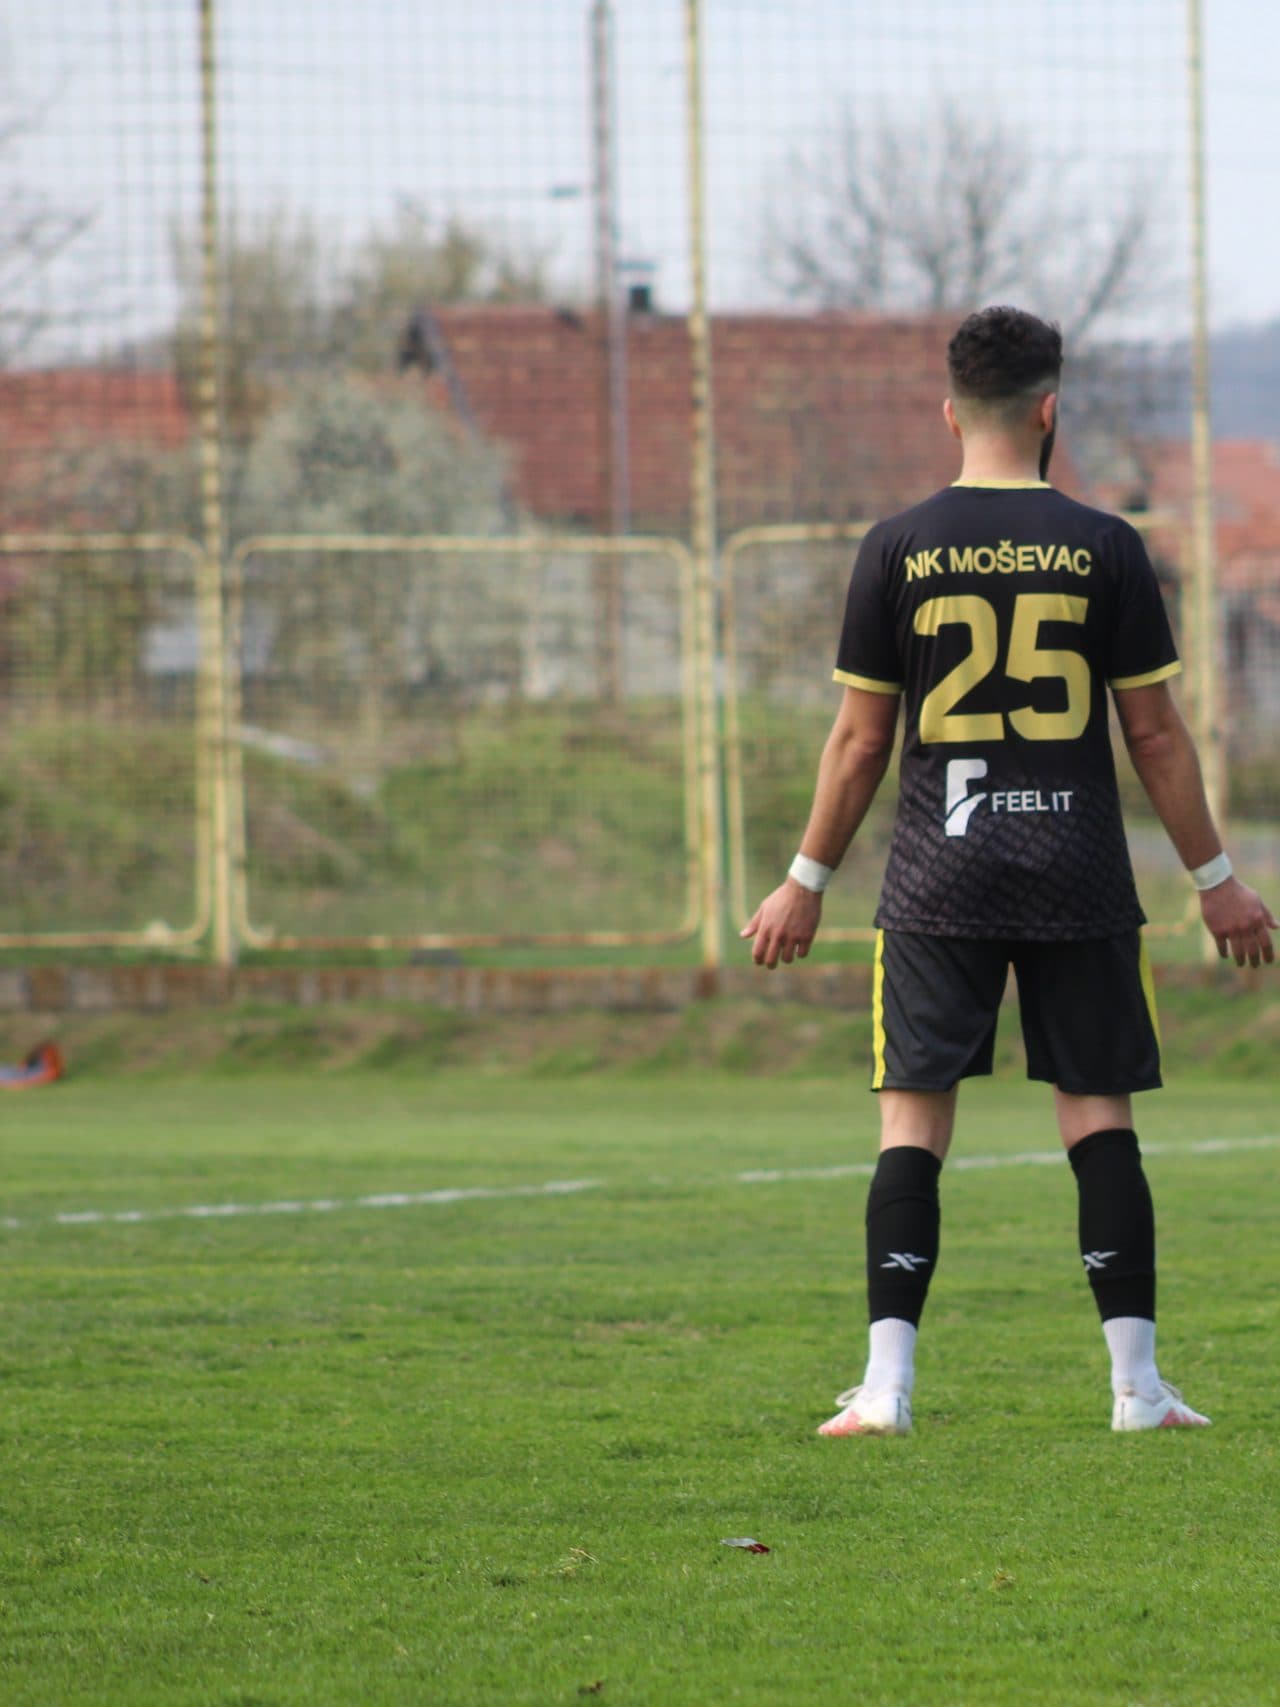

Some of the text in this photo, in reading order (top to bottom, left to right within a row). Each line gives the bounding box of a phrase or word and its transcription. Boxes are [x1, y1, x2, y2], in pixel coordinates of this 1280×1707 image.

[905, 540, 1092, 582] NK MOŠEVAC
[913, 593, 1091, 744] 25
[991, 790, 1074, 813] FEEL IT
